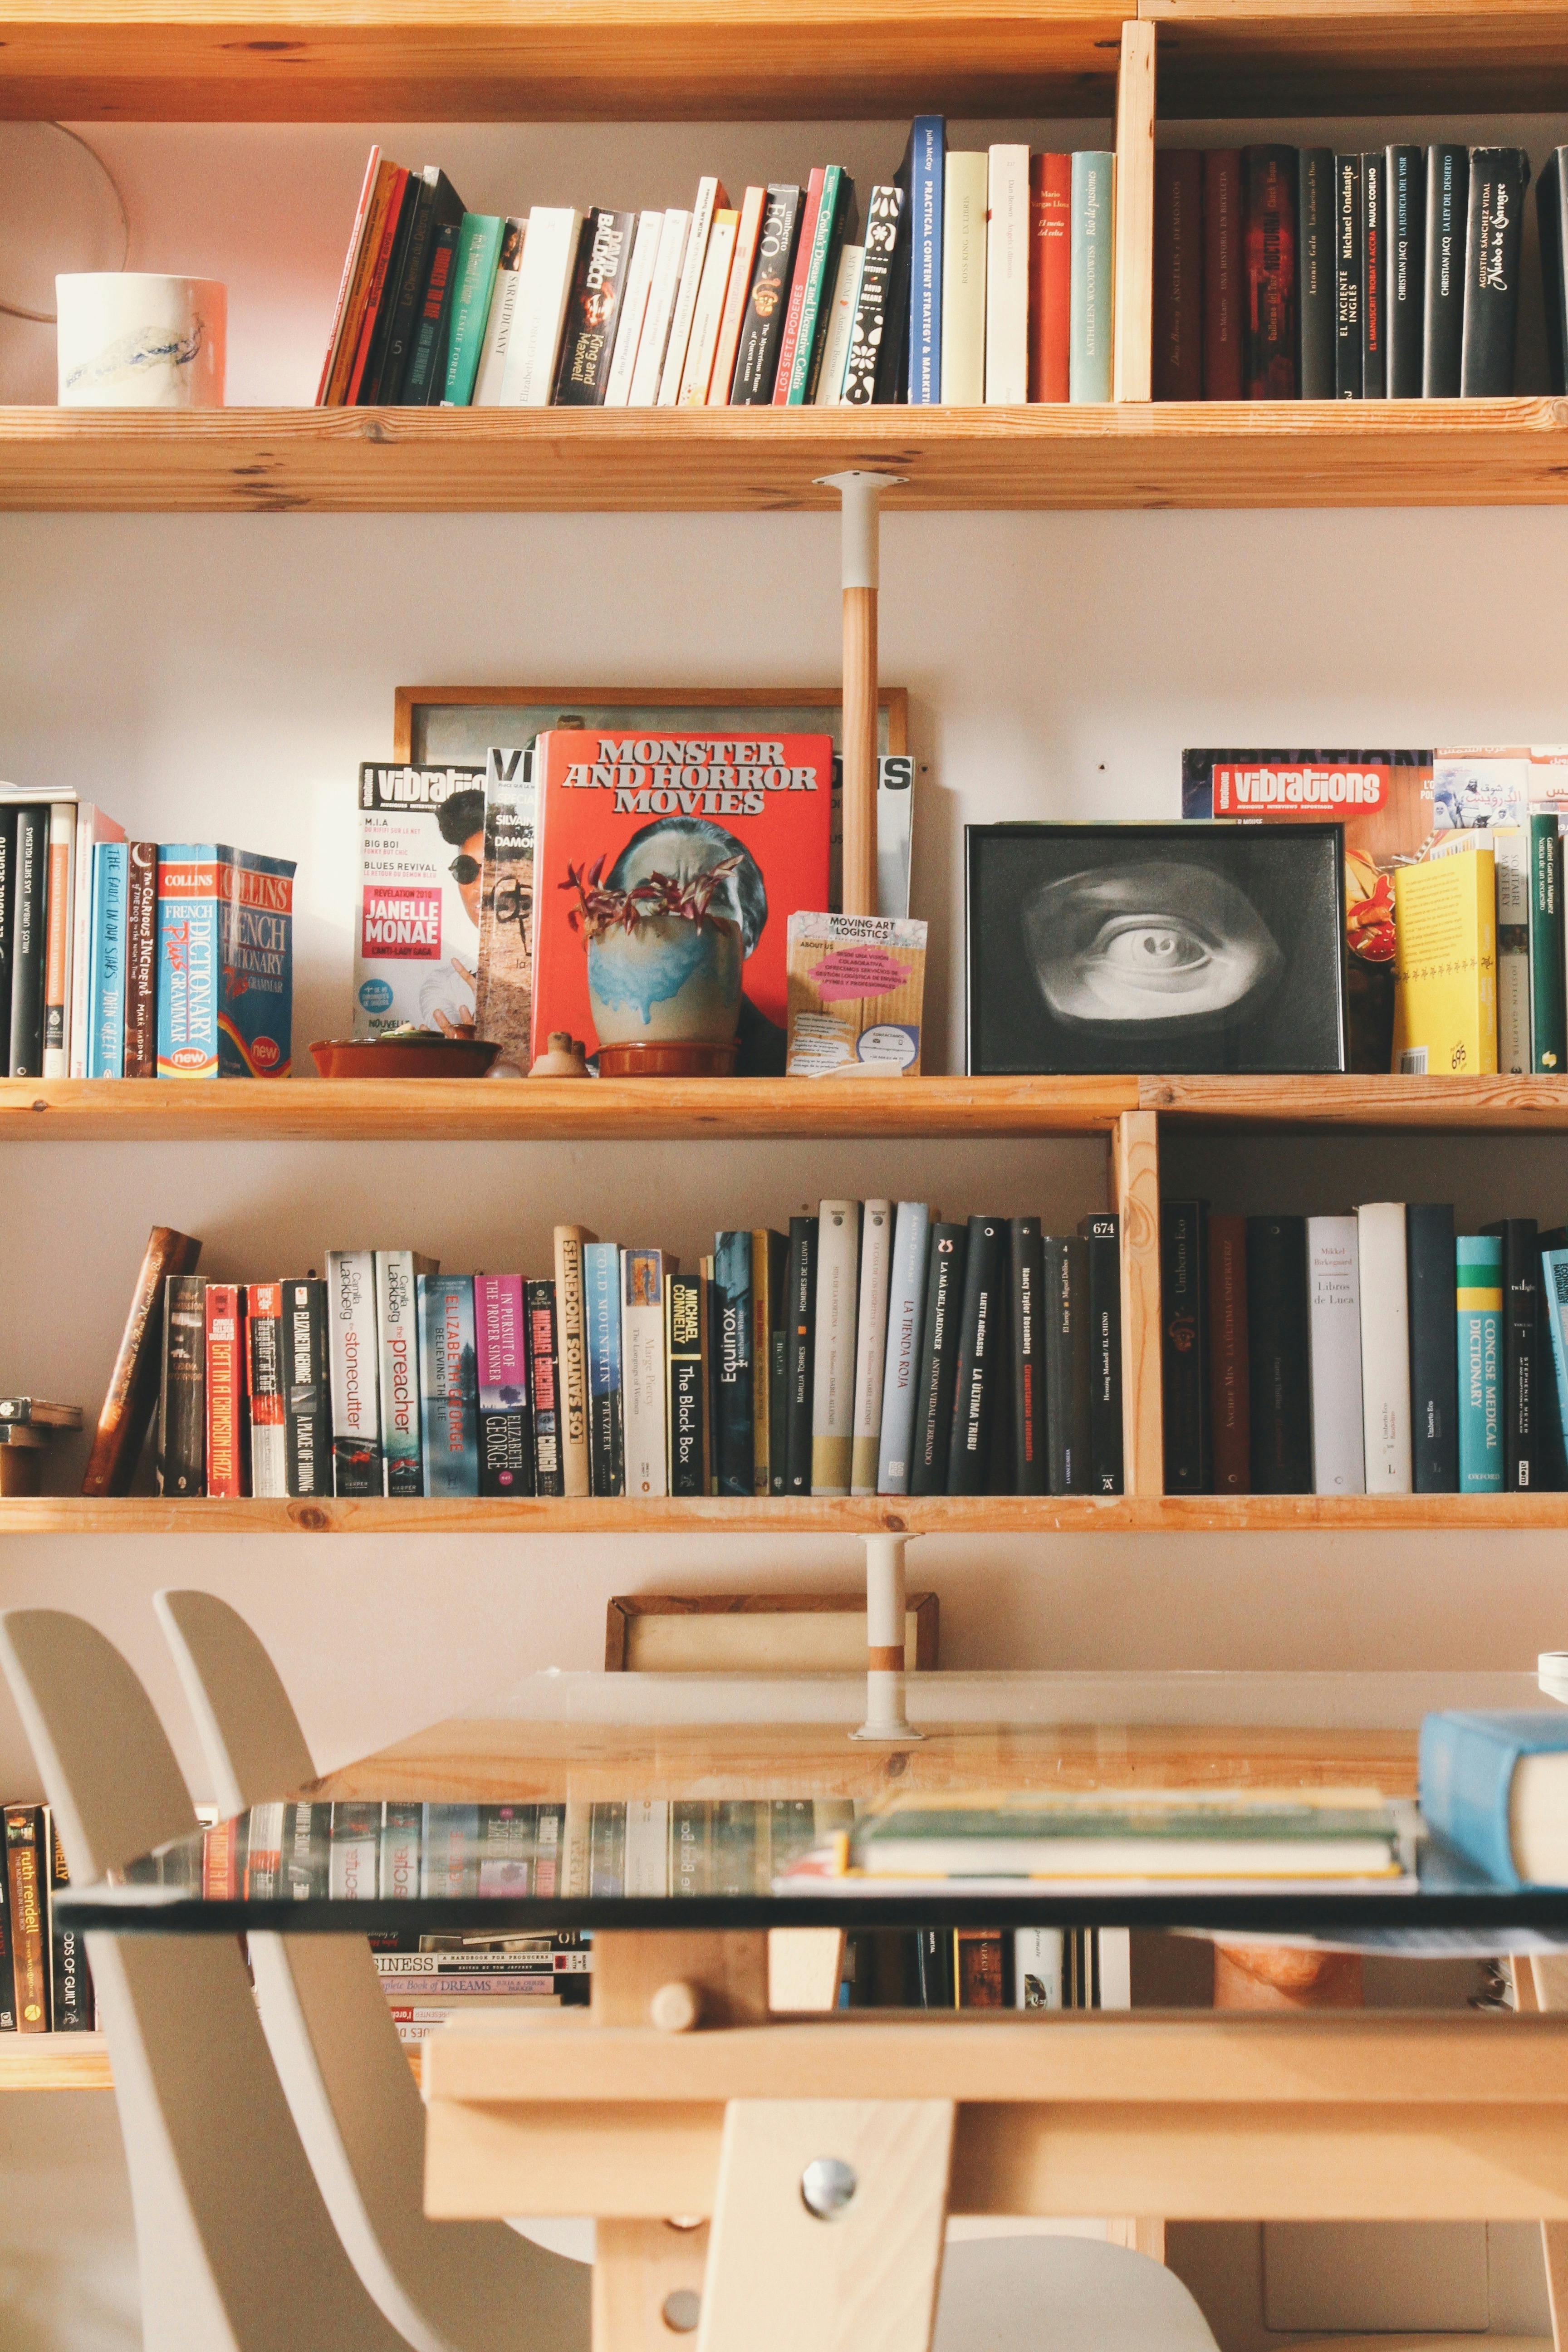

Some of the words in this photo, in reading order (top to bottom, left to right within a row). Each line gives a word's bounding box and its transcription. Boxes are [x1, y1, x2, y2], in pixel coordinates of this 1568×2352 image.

[761, 204, 784, 257] ECO
[781, 211, 791, 251] umberto
[816, 209, 830, 247] Crohn's
[1343, 216, 1351, 258] Michael
[1443, 222, 1449, 231] LA
[590, 212, 613, 290] BALDACCI
[601, 230, 623, 278] DAVID
[810, 248, 823, 284] Disease
[504, 276, 517, 310] SARAH
[807, 286, 818, 305] and
[861, 293, 882, 303] MEANS
[864, 284, 882, 293] DAVID
[788, 284, 803, 335] PODERES
[496, 313, 510, 353] DUNANT
[797, 307, 814, 362] Ulcerative
[1340, 326, 1347, 336] EL
[571, 332, 591, 382] Maxwell
[586, 333, 603, 366] King
[756, 337, 767, 368] Mysterious
[783, 338, 794, 368] SIETE
[583, 366, 597, 386] and
[752, 370, 760, 392] Flame
[779, 370, 788, 392] LOS
[793, 363, 805, 390] Colitis
[598, 740, 785, 765] MONSTER
[563, 764, 646, 788] AND
[652, 766, 817, 790] HORROR
[1235, 770, 1380, 803] Vibrations
[614, 790, 764, 814] MOVIES
[108, 851, 119, 867] THE
[364, 862, 394, 870] BLUES
[397, 862, 436, 871] REVIVAL
[108, 877, 118, 902] FAULT
[165, 875, 213, 886] COLLINS
[107, 909, 118, 920] IN
[165, 906, 213, 919] FRENCH
[365, 900, 438, 920] JANELLE
[830, 917, 872, 928] MOVING
[875, 922, 895, 930] ART
[106, 924, 117, 941] OUR
[365, 920, 438, 944] MONAE
[836, 927, 888, 939] LOGISTICS
[104, 947, 117, 978] STARS
[188, 920, 212, 1044] DICTIONARY
[103, 991, 117, 1017] JOHN
[171, 970, 186, 1042] GRAMMAR
[102, 1022, 116, 1058] GREEN
[175, 1050, 205, 1063] new
[1093, 1223, 1114, 1234] 674
[597, 1248, 606, 1290] COLD
[801, 1267, 807, 1276] DE
[1314, 1259, 1352, 1267] Birkegaard
[487, 1282, 497, 1299] THE
[501, 1293, 512, 1304] IN
[564, 1240, 579, 1335] INOCENTES
[1314, 1295, 1325, 1304] de
[1330, 1295, 1353, 1304] Luca
[1318, 1282, 1350, 1291] Libros
[674, 1284, 686, 1343] CONNELLY
[683, 1289, 697, 1341] MICHAEL
[904, 1300, 913, 1313] LA
[294, 1311, 310, 1357] ELIZABETH
[487, 1304, 499, 1340] PROPER
[501, 1308, 514, 1348] PURSUIT
[533, 1309, 551, 1354] MICHAEL
[446, 1294, 460, 1383] ELIZABETH
[598, 1299, 608, 1382] MOUNTAIN
[720, 1307, 736, 1383] Equinox
[901, 1319, 911, 1356] TIENDA
[1486, 1318, 1494, 1380] CONCISE
[436, 1328, 444, 1379] BELIEVING
[489, 1345, 500, 1380] SINNER
[503, 1353, 514, 1366] OF
[1470, 1319, 1481, 1407] DICTIONARY
[295, 1357, 310, 1383] GEORGE
[345, 1332, 362, 1430] stonecutter
[535, 1357, 554, 1410] CRICHTON
[567, 1338, 582, 1407] SANTOS
[679, 1365, 693, 1392] The
[898, 1361, 908, 1387] ROJA
[973, 1368, 982, 1380] LA
[387, 1338, 414, 1434] preacher
[970, 1382, 981, 1418] ÚLTIMA
[438, 1405, 446, 1421] LIE
[448, 1387, 464, 1453] GEORGE
[569, 1410, 583, 1445] LOS
[679, 1395, 695, 1432] Black
[1486, 1385, 1496, 1449] MEDICAL
[297, 1423, 312, 1447] PLACE
[485, 1416, 508, 1470] GEORGE
[507, 1415, 521, 1468] ELIZABETH
[679, 1436, 692, 1463] Box
[967, 1422, 977, 1450] TRIBU
[298, 1449, 313, 1460] OF
[538, 1435, 556, 1472] CONGO
[298, 1462, 314, 1491] HIDING
[21, 1851, 33, 1880] ruth
[24, 1884, 38, 1934] rendell
[64, 1958, 74, 1973] OF
[65, 1976, 75, 2005] GUILT
[407, 1979, 427, 1990] Book
[430, 1979, 440, 1991] of
[441, 1981, 491, 1991] DREAMS
